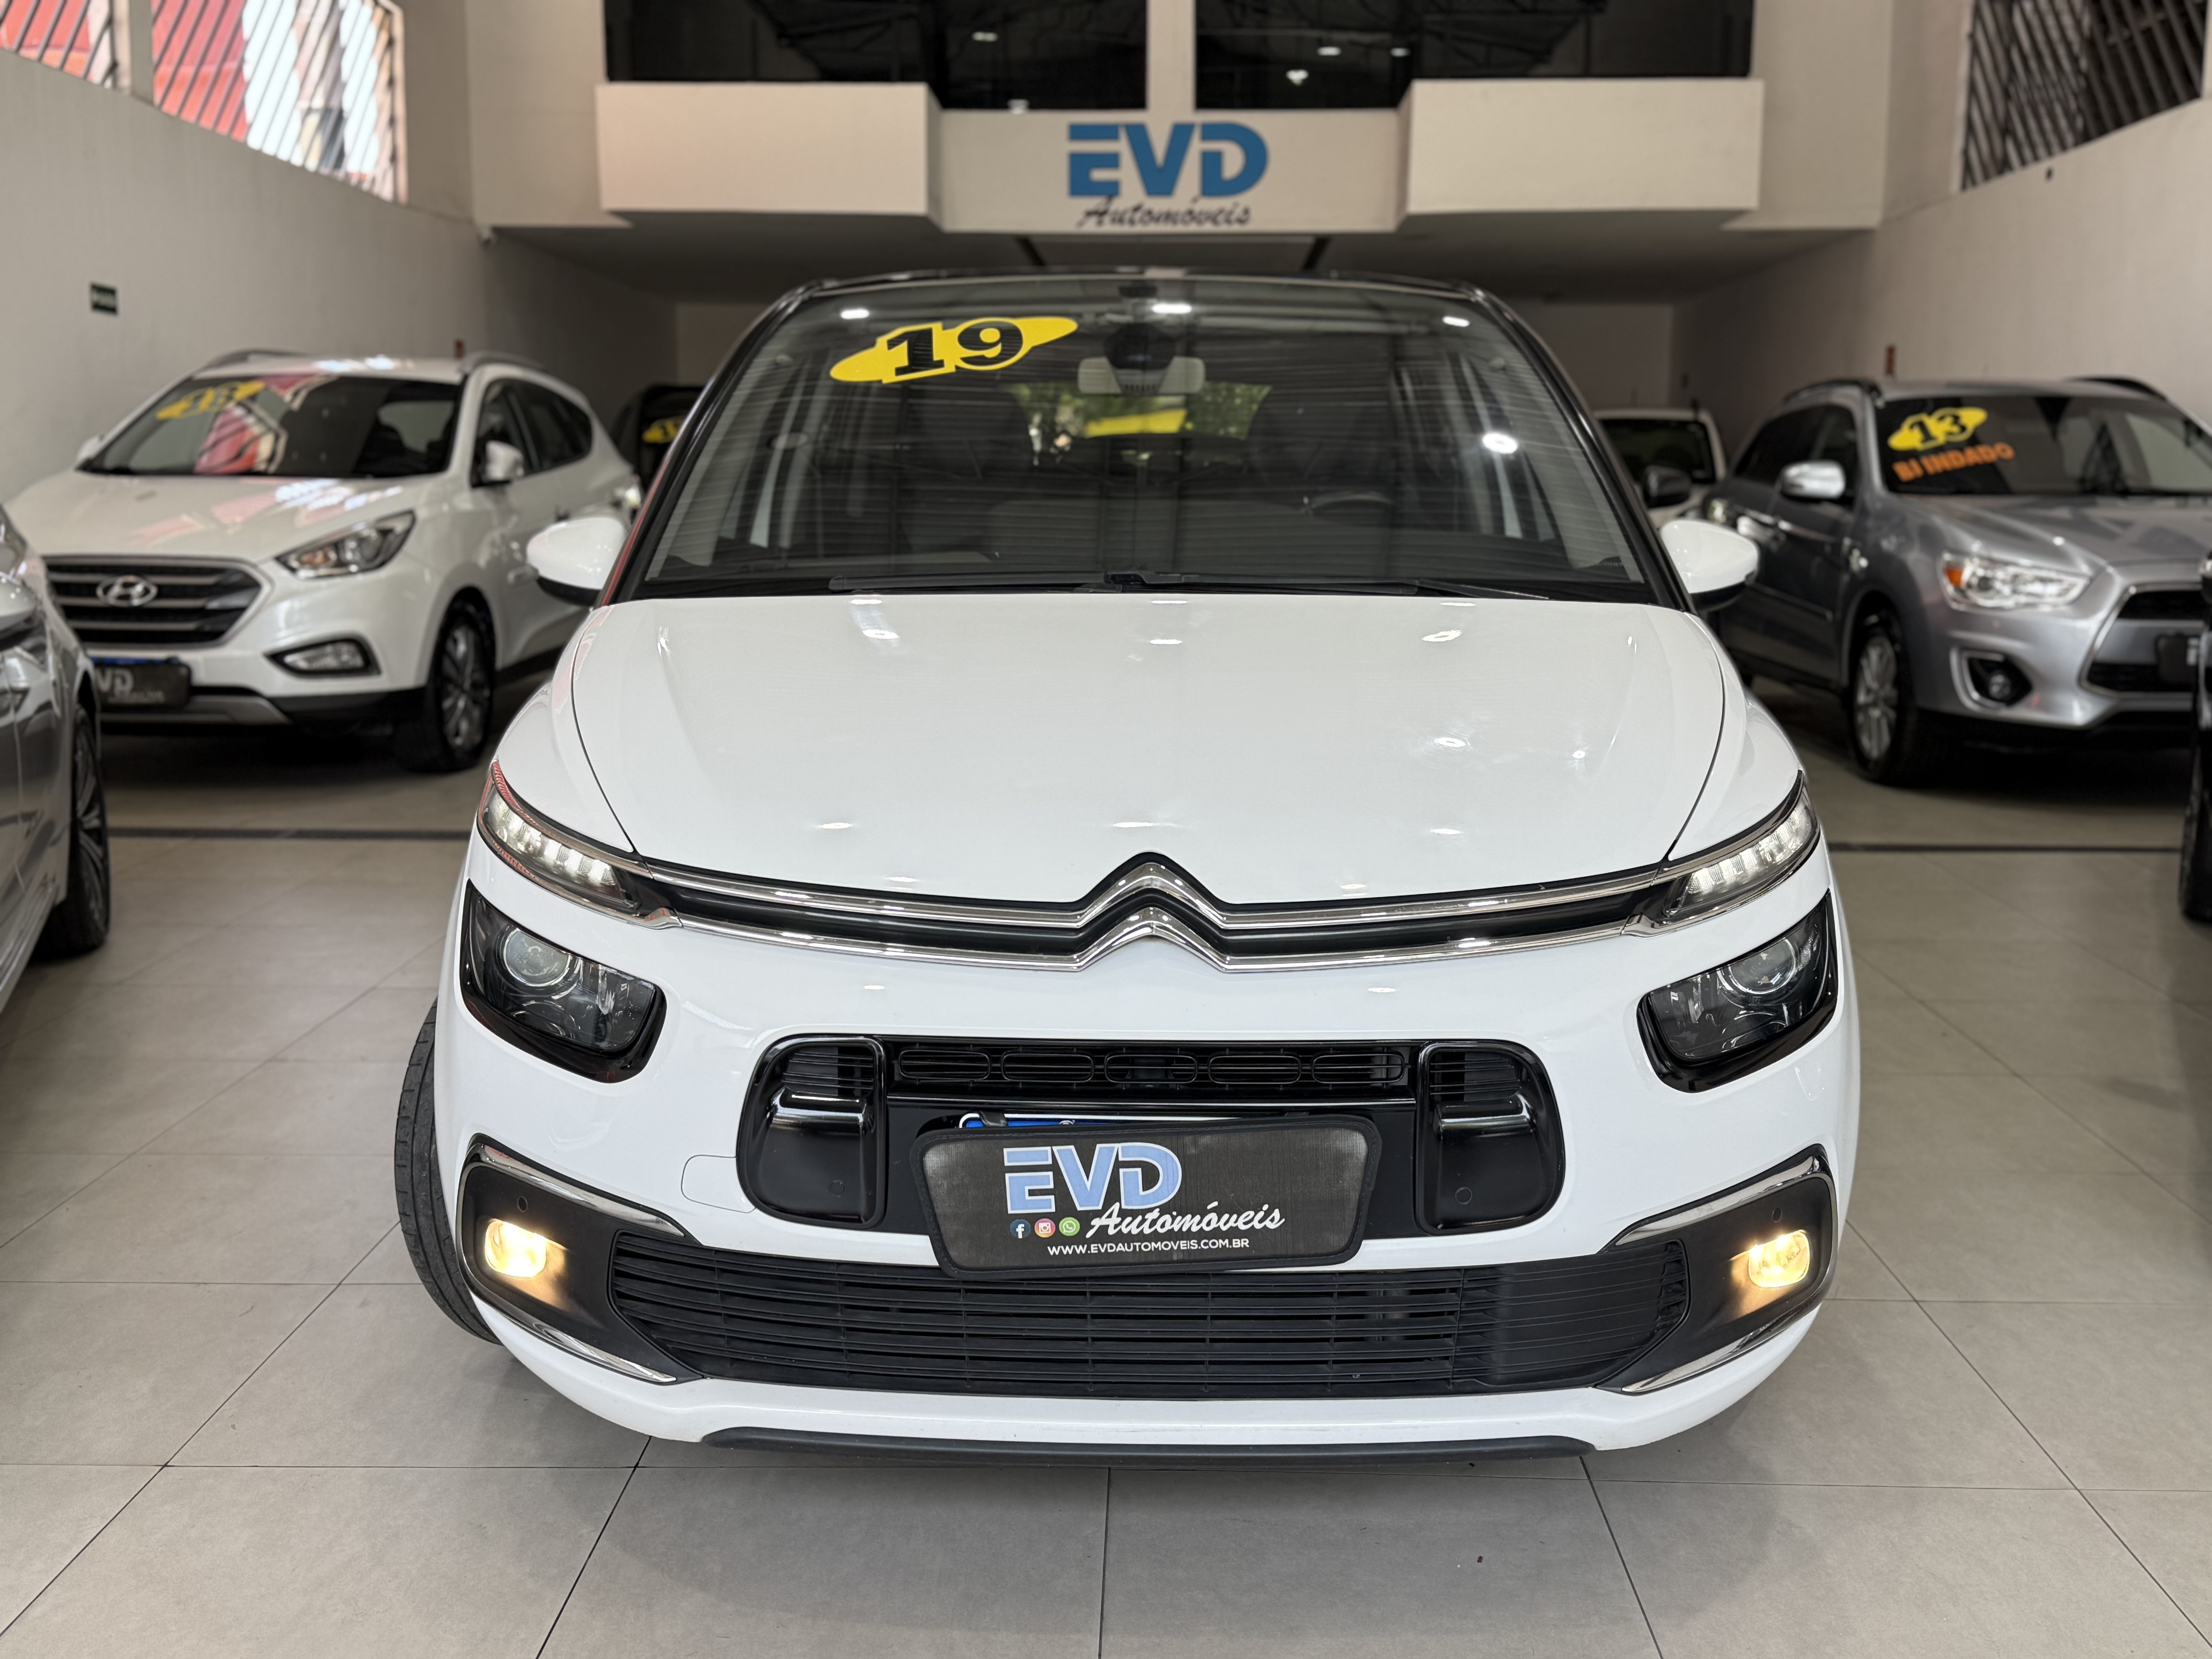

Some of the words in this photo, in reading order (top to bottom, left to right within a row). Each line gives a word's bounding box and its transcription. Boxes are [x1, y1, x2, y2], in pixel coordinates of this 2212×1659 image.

[1068, 122, 1268, 197] EVD
[1076, 193, 1251, 228] Automóveis
[886, 320, 1024, 376] 19
[1910, 413, 1968, 443] 13
[1003, 1142, 1182, 1214] EVD
[1085, 1201, 1285, 1238] Automóveis
[1047, 1238, 1249, 1255] WWW.EVDAUTOMOVEIS.COM.BR
